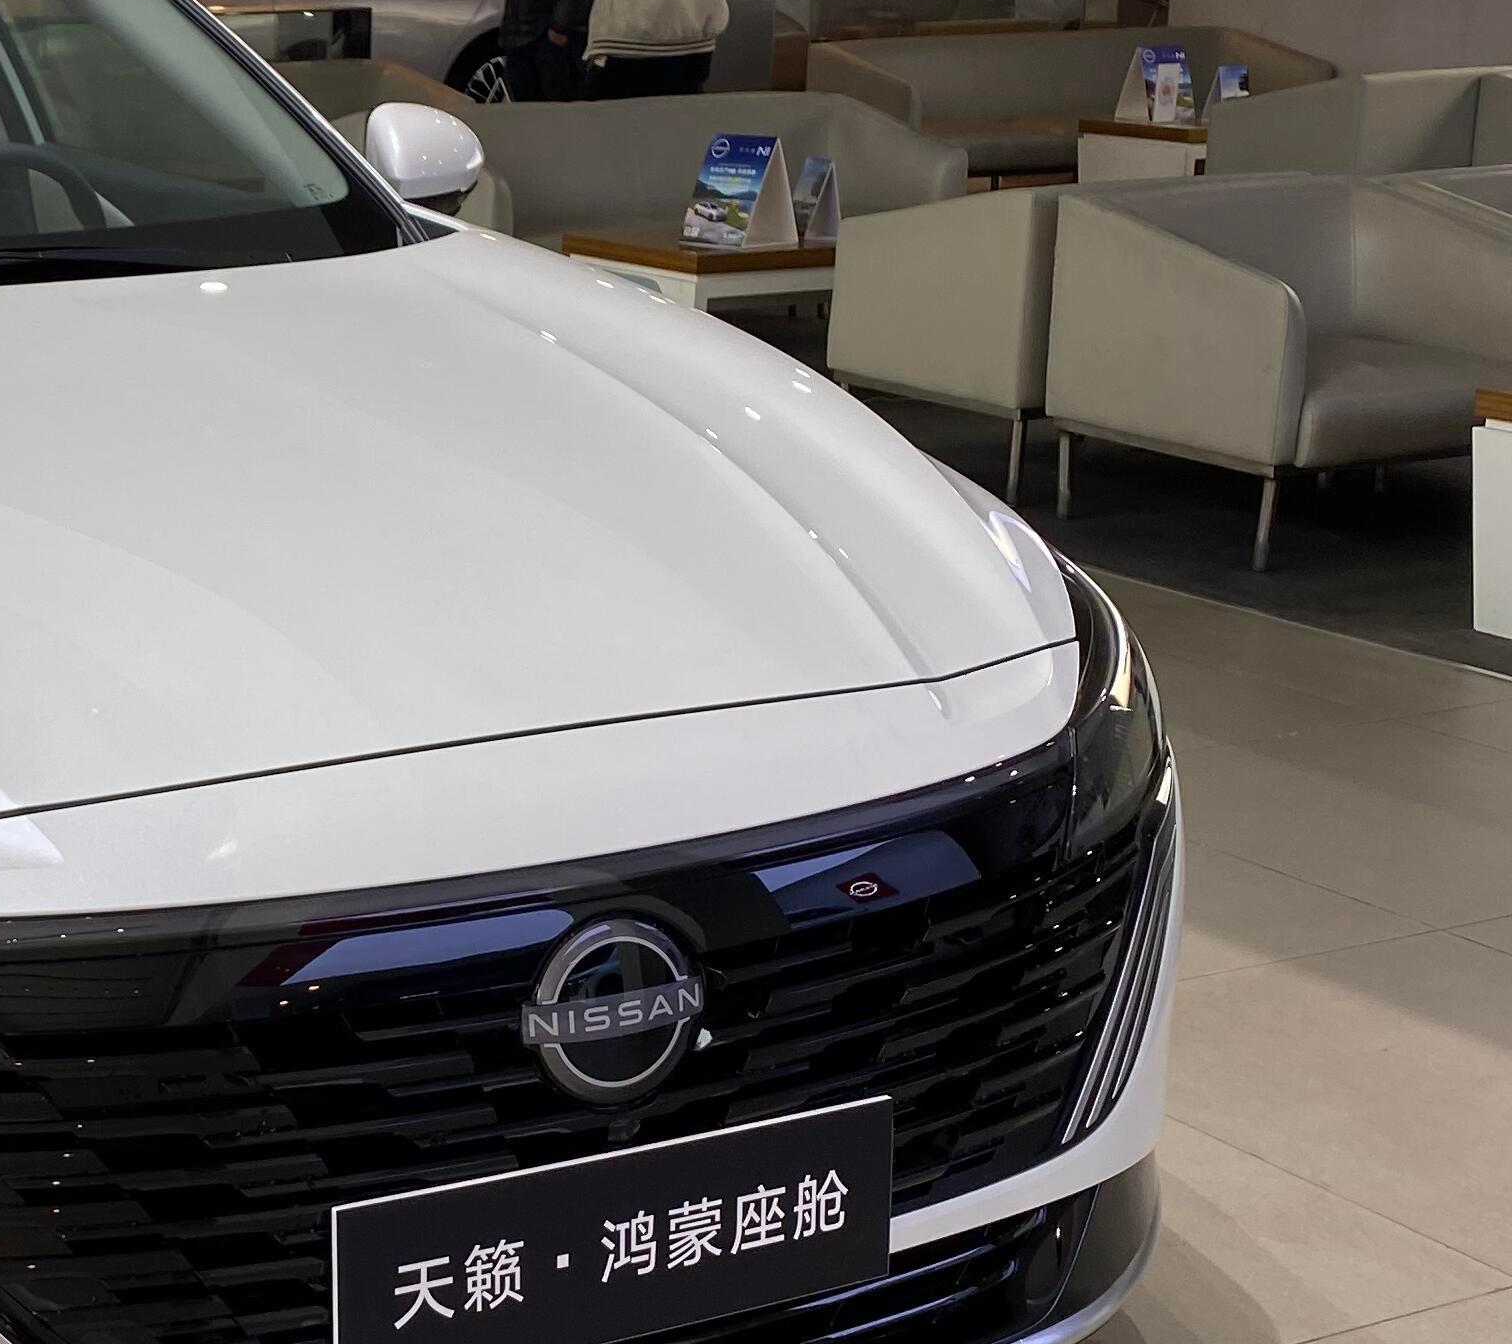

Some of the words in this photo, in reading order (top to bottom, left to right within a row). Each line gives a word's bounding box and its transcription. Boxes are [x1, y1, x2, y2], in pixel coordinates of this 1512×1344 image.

[527, 983, 701, 1038] NISSAN
[394, 1169, 849, 1330] 天籁·鸿蒙座舱
